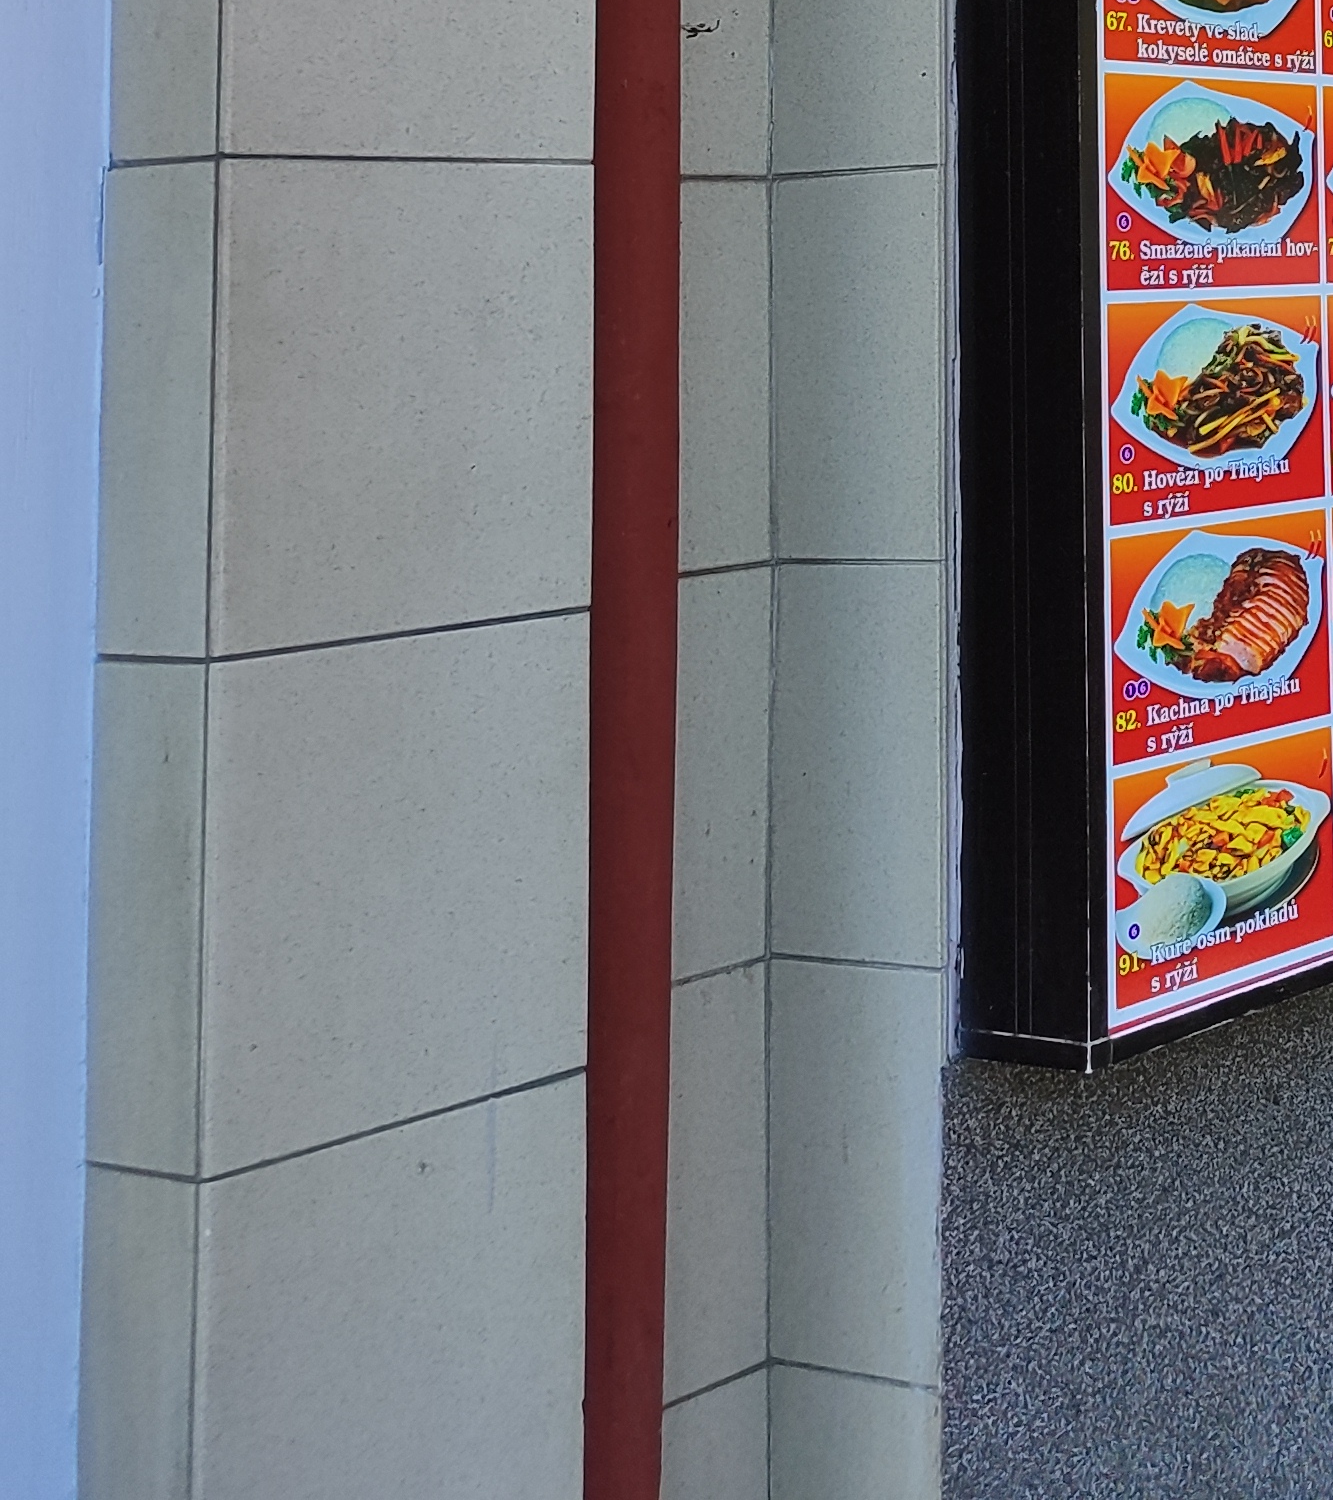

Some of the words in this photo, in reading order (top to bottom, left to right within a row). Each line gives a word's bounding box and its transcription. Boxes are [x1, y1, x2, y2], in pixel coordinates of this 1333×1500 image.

[1106, 11, 1132, 32] 67.
[1137, 13, 1200, 43] Krevety
[1205, 24, 1224, 39] ve
[1137, 38, 1209, 65] kokyselé
[1213, 43, 1270, 67] omáčce
[1275, 54, 1282, 68] s
[1287, 50, 1314, 73] rýží
[1109, 240, 1135, 261] 76.
[1140, 239, 1212, 260] Smažené
[1217, 237, 1282, 264] pikantní
[1140, 265, 1164, 286] ězí
[1169, 270, 1177, 284] s
[1182, 264, 1214, 288] rýží
[1113, 472, 1138, 494] 80.
[1143, 464, 1199, 491] Hovězí
[1204, 467, 1223, 488] po
[1229, 456, 1289, 482] Thajsku
[1144, 501, 1152, 516] s
[1157, 491, 1189, 519] rýží
[1116, 709, 1141, 733] 82.
[1146, 697, 1209, 727] Kachna
[1214, 693, 1233, 716] po
[1238, 675, 1300, 705] Thajsku
[1147, 736, 1156, 752] s
[1161, 722, 1194, 752] rýží
[1119, 953, 1145, 976] 91.
[1151, 936, 1192, 966] Kuře
[1197, 926, 1231, 950] osm
[1151, 976, 1160, 993] s
[1165, 958, 1198, 991] rýží
